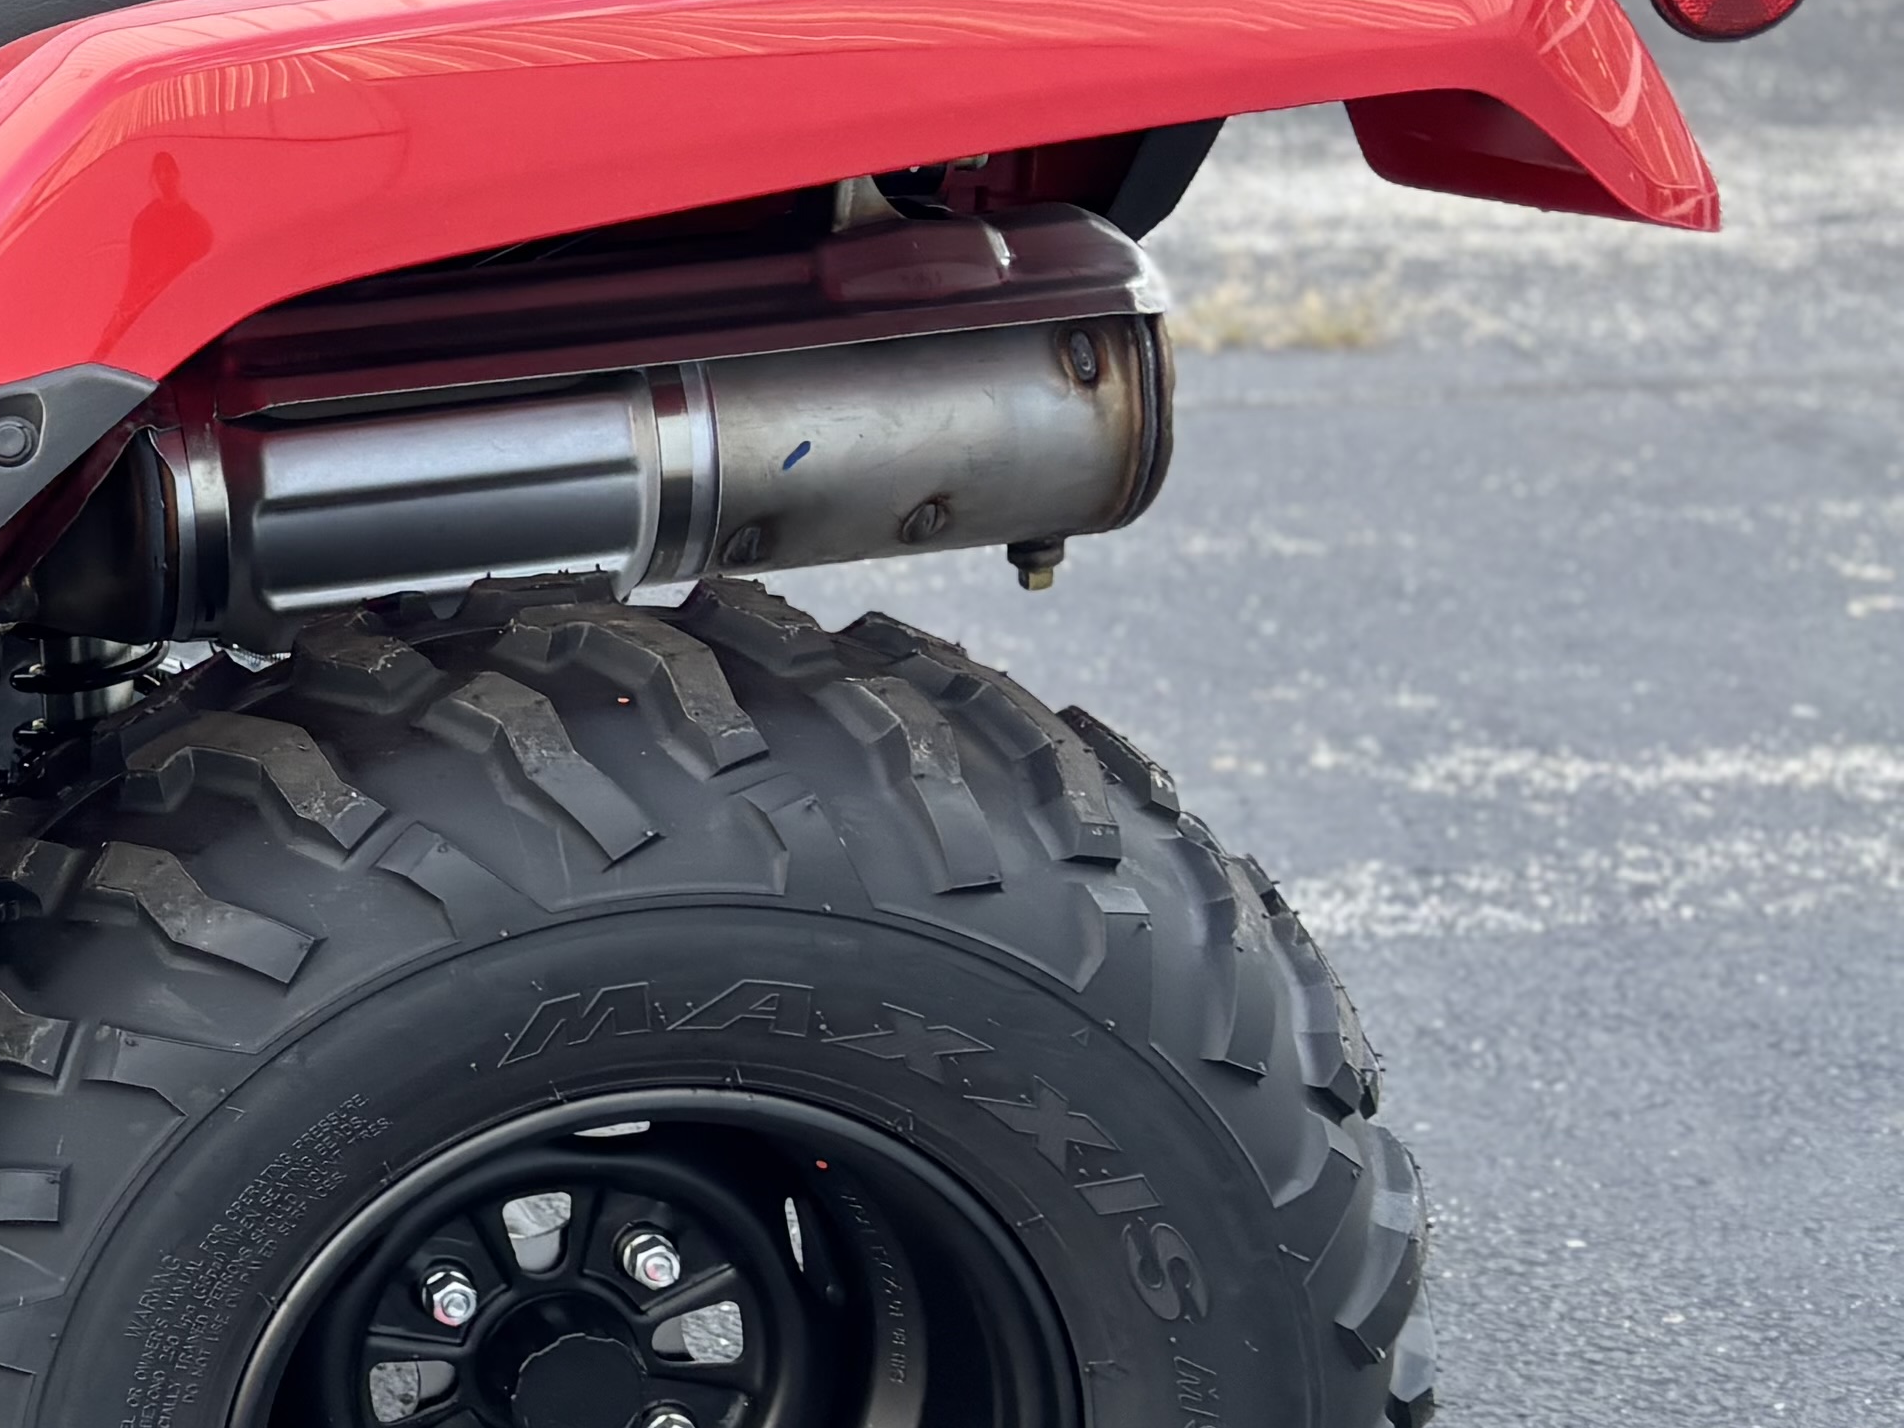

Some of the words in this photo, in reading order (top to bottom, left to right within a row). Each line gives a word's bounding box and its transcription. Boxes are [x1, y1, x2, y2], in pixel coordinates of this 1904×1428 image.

[496, 978, 1212, 1323] MAXXIS
[125, 1386, 142, 1407] OR
[198, 1221, 229, 1253] FOR
[182, 1381, 201, 1403] DO
